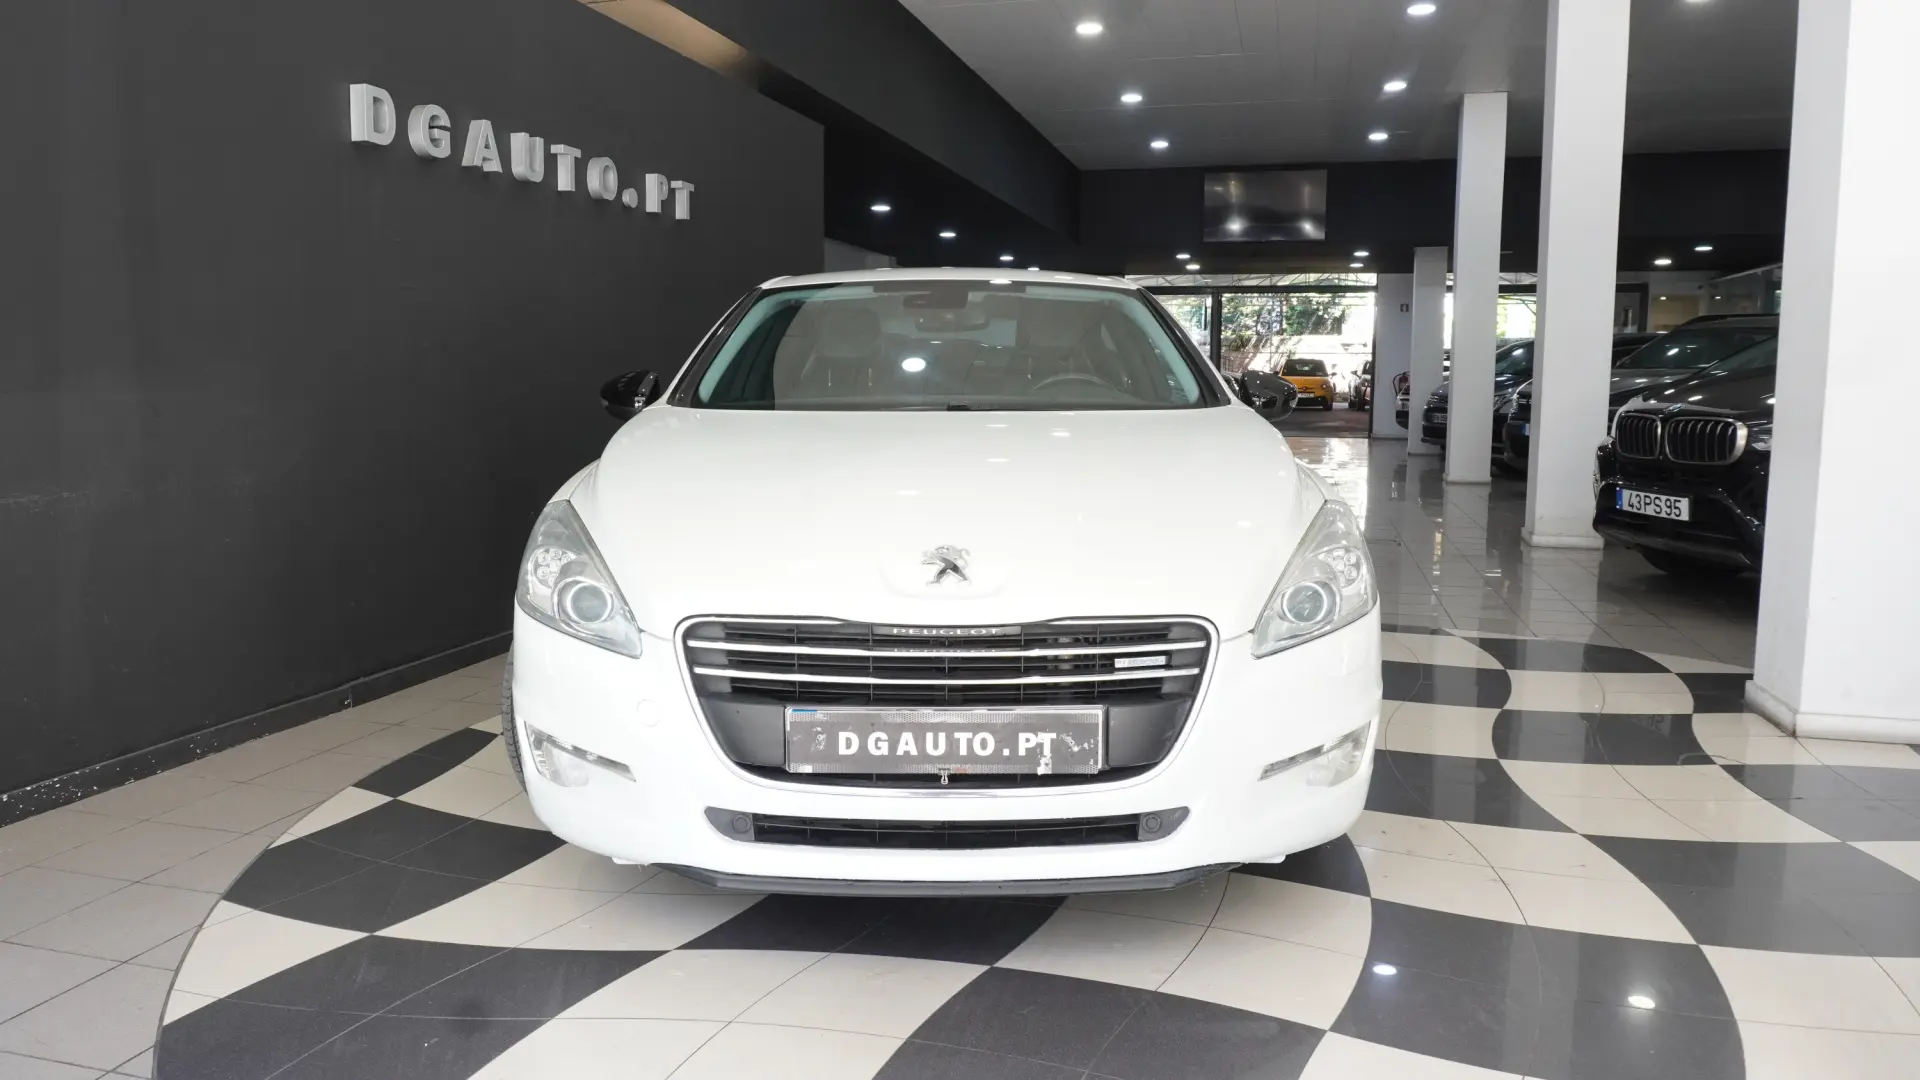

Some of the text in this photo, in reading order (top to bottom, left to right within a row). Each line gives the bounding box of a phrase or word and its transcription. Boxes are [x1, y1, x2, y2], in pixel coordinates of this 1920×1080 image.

[350, 83, 695, 220] DGAUTO.PT
[1627, 492, 1682, 518] 43PS95
[893, 627, 1003, 635] PEUGEOT
[838, 731, 1057, 757] DGAUTO.PT
